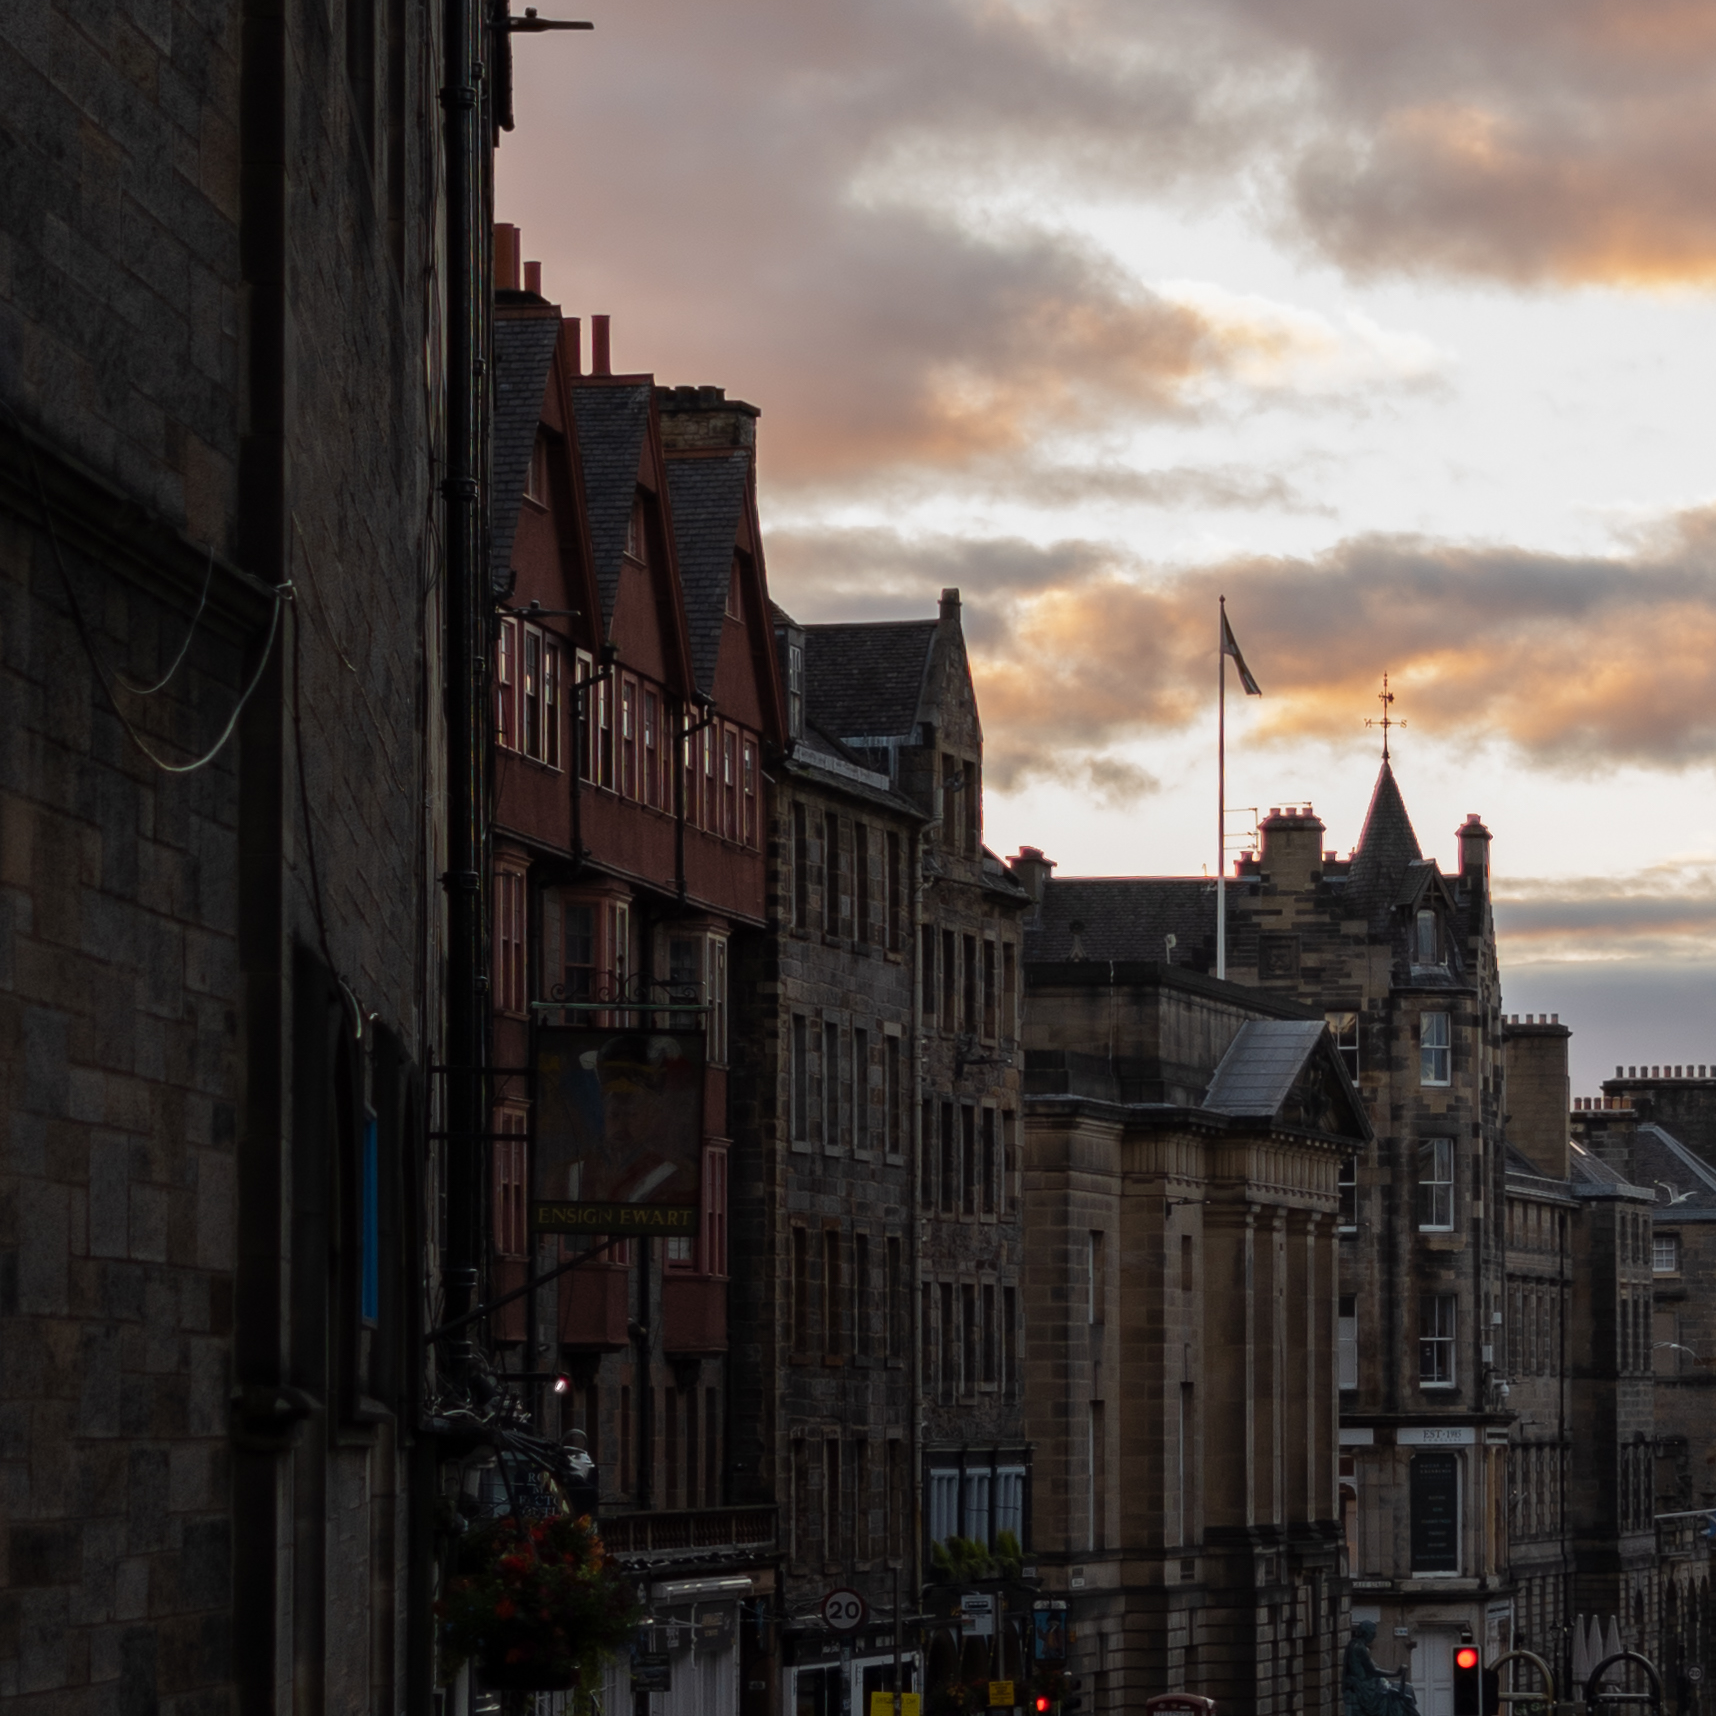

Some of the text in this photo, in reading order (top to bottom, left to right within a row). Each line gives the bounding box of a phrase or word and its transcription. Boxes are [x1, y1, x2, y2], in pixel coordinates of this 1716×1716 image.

[538, 1207, 692, 1226] ENSIGN EWART
[829, 1601, 860, 1619] 20
